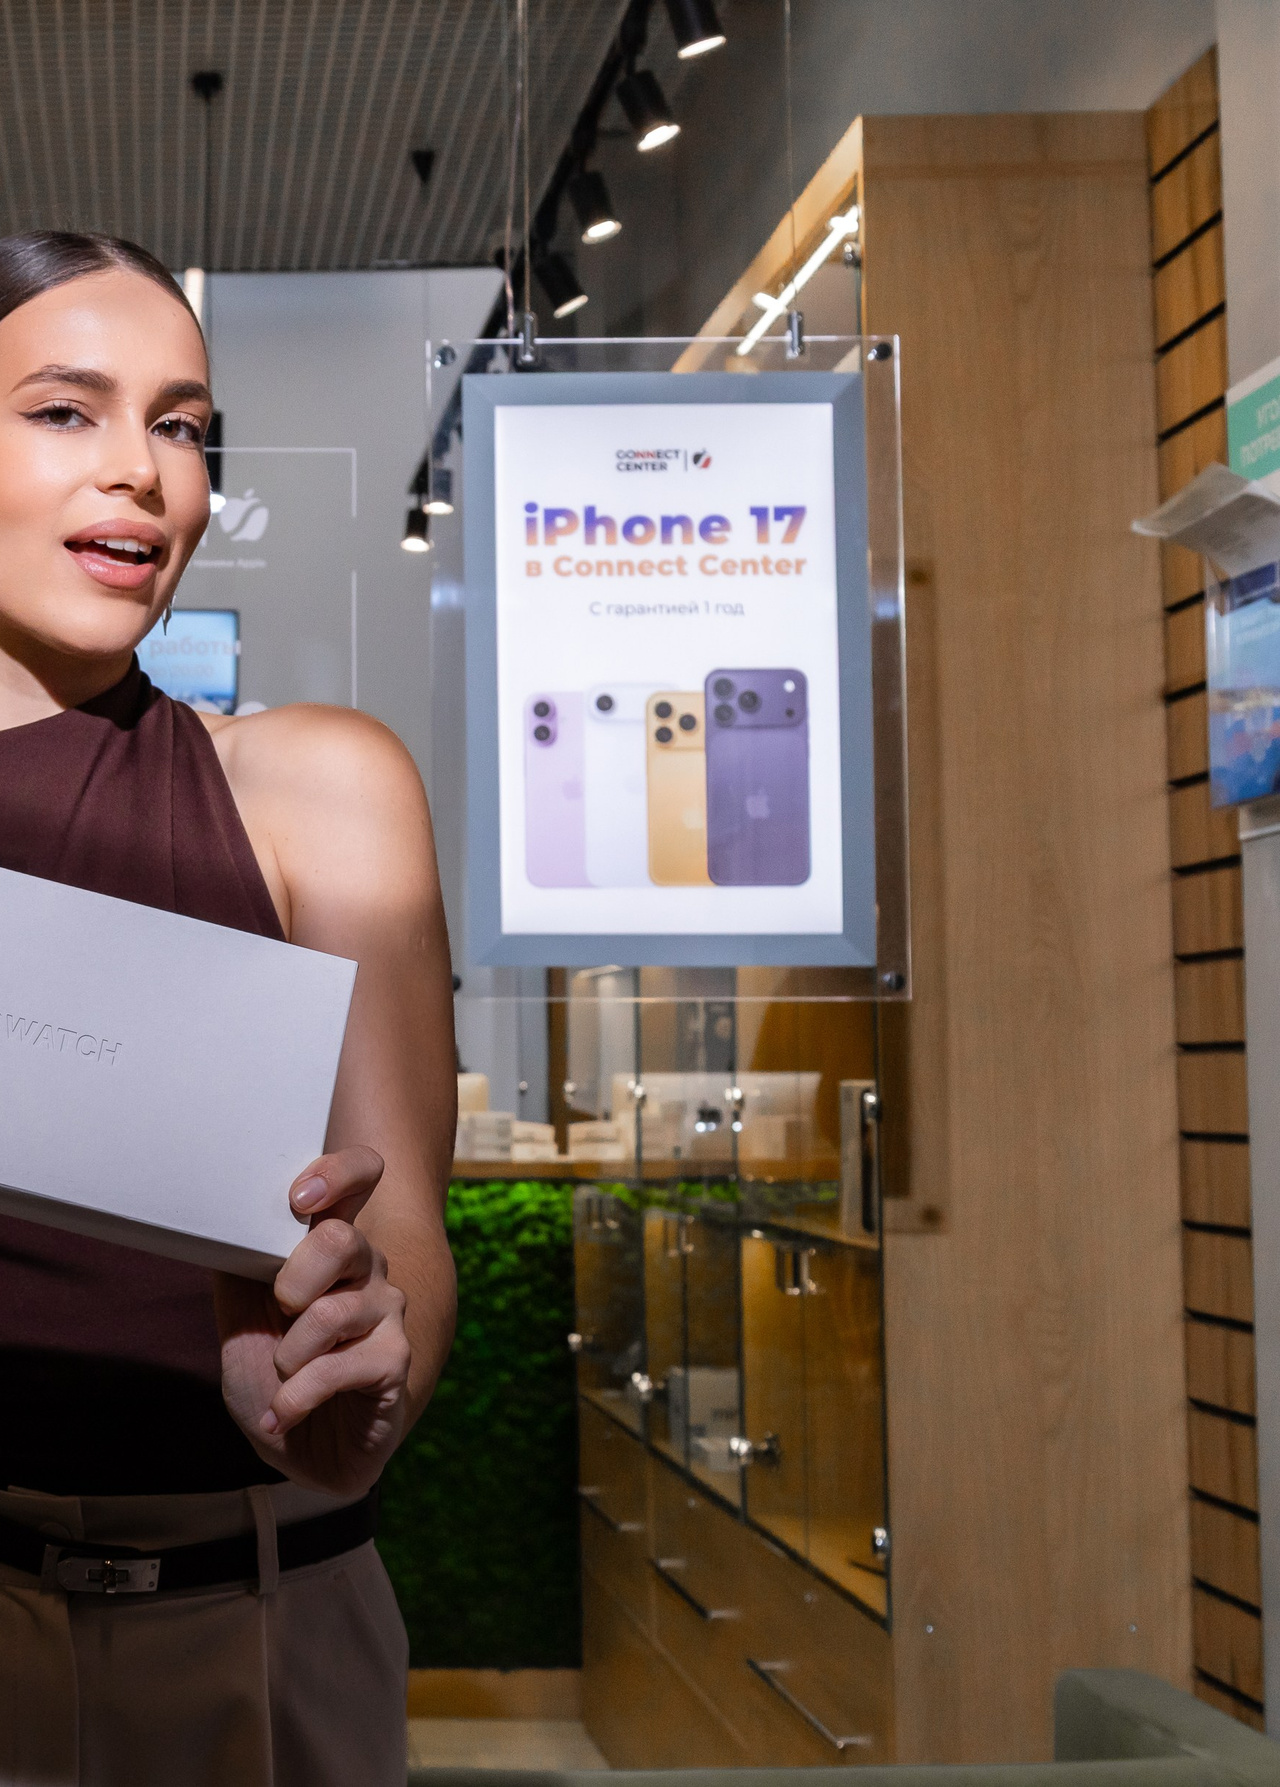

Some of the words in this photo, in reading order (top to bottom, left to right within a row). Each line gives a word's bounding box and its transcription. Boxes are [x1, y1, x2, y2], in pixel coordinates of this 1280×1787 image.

[616, 449, 681, 461] CONNECT
[616, 461, 669, 472] CENTER
[524, 501, 732, 546] iPhone
[749, 505, 807, 544] 17
[525, 560, 542, 577] в
[553, 555, 688, 577] Connect
[698, 554, 807, 576] Center
[589, 601, 602, 615] С
[607, 600, 699, 617] гарантией
[704, 601, 710, 614] 1
[715, 602, 745, 616] год
[150, 636, 242, 659] работы
[6, 1013, 123, 1066] WATCH
